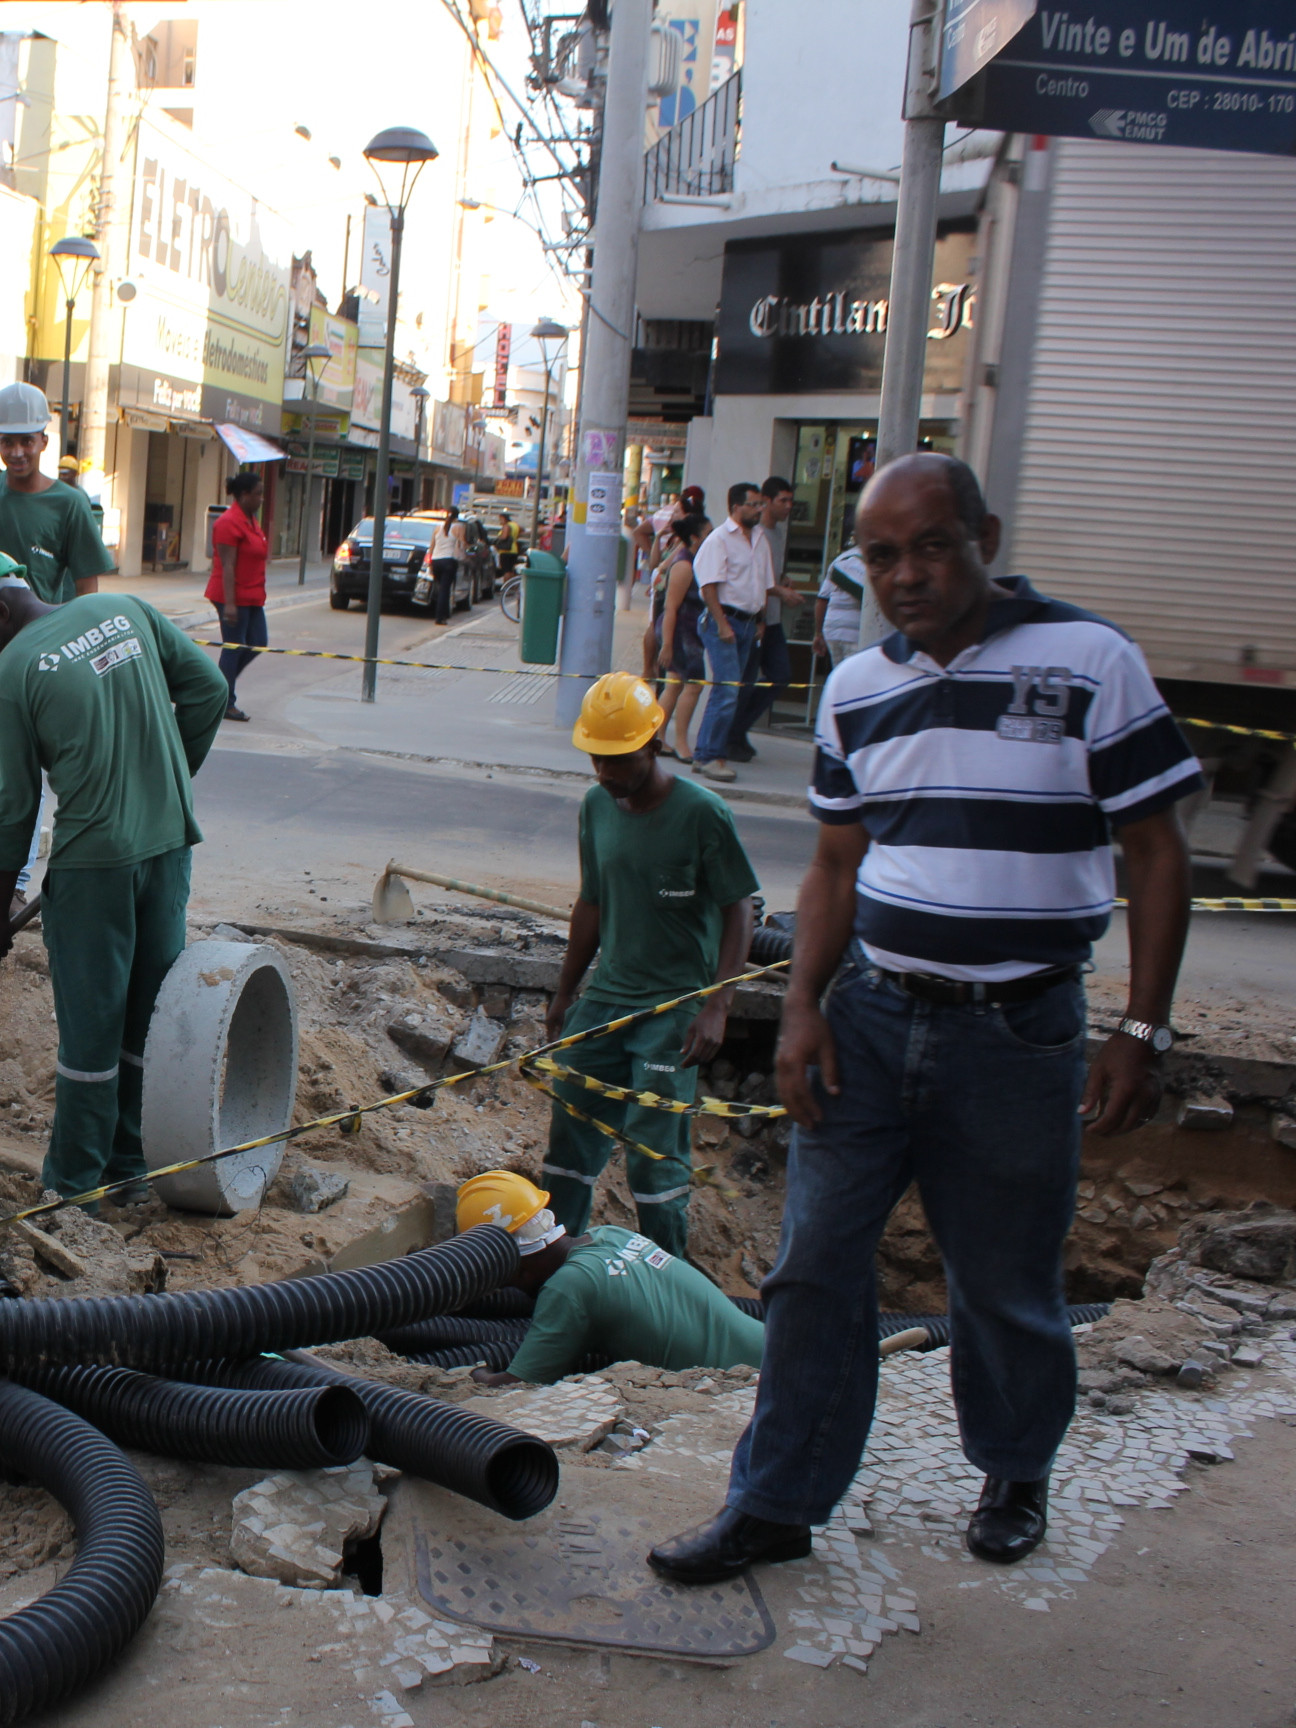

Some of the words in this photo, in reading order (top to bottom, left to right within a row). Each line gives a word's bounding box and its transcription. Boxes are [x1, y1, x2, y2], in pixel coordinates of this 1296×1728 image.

[1041, 10, 1110, 55] Vinte
[1118, 30, 1136, 57] e
[1144, 21, 1189, 62] Um
[1197, 26, 1231, 66] de
[1236, 28, 1296, 71] Abri
[1036, 73, 1089, 98] Centro
[1167, 90, 1200, 110] CEP
[1126, 112, 1167, 126] PMCG
[1125, 126, 1166, 141] EMUT
[139, 157, 230, 297] ELETRO
[60, 615, 131, 659] IMBEG
